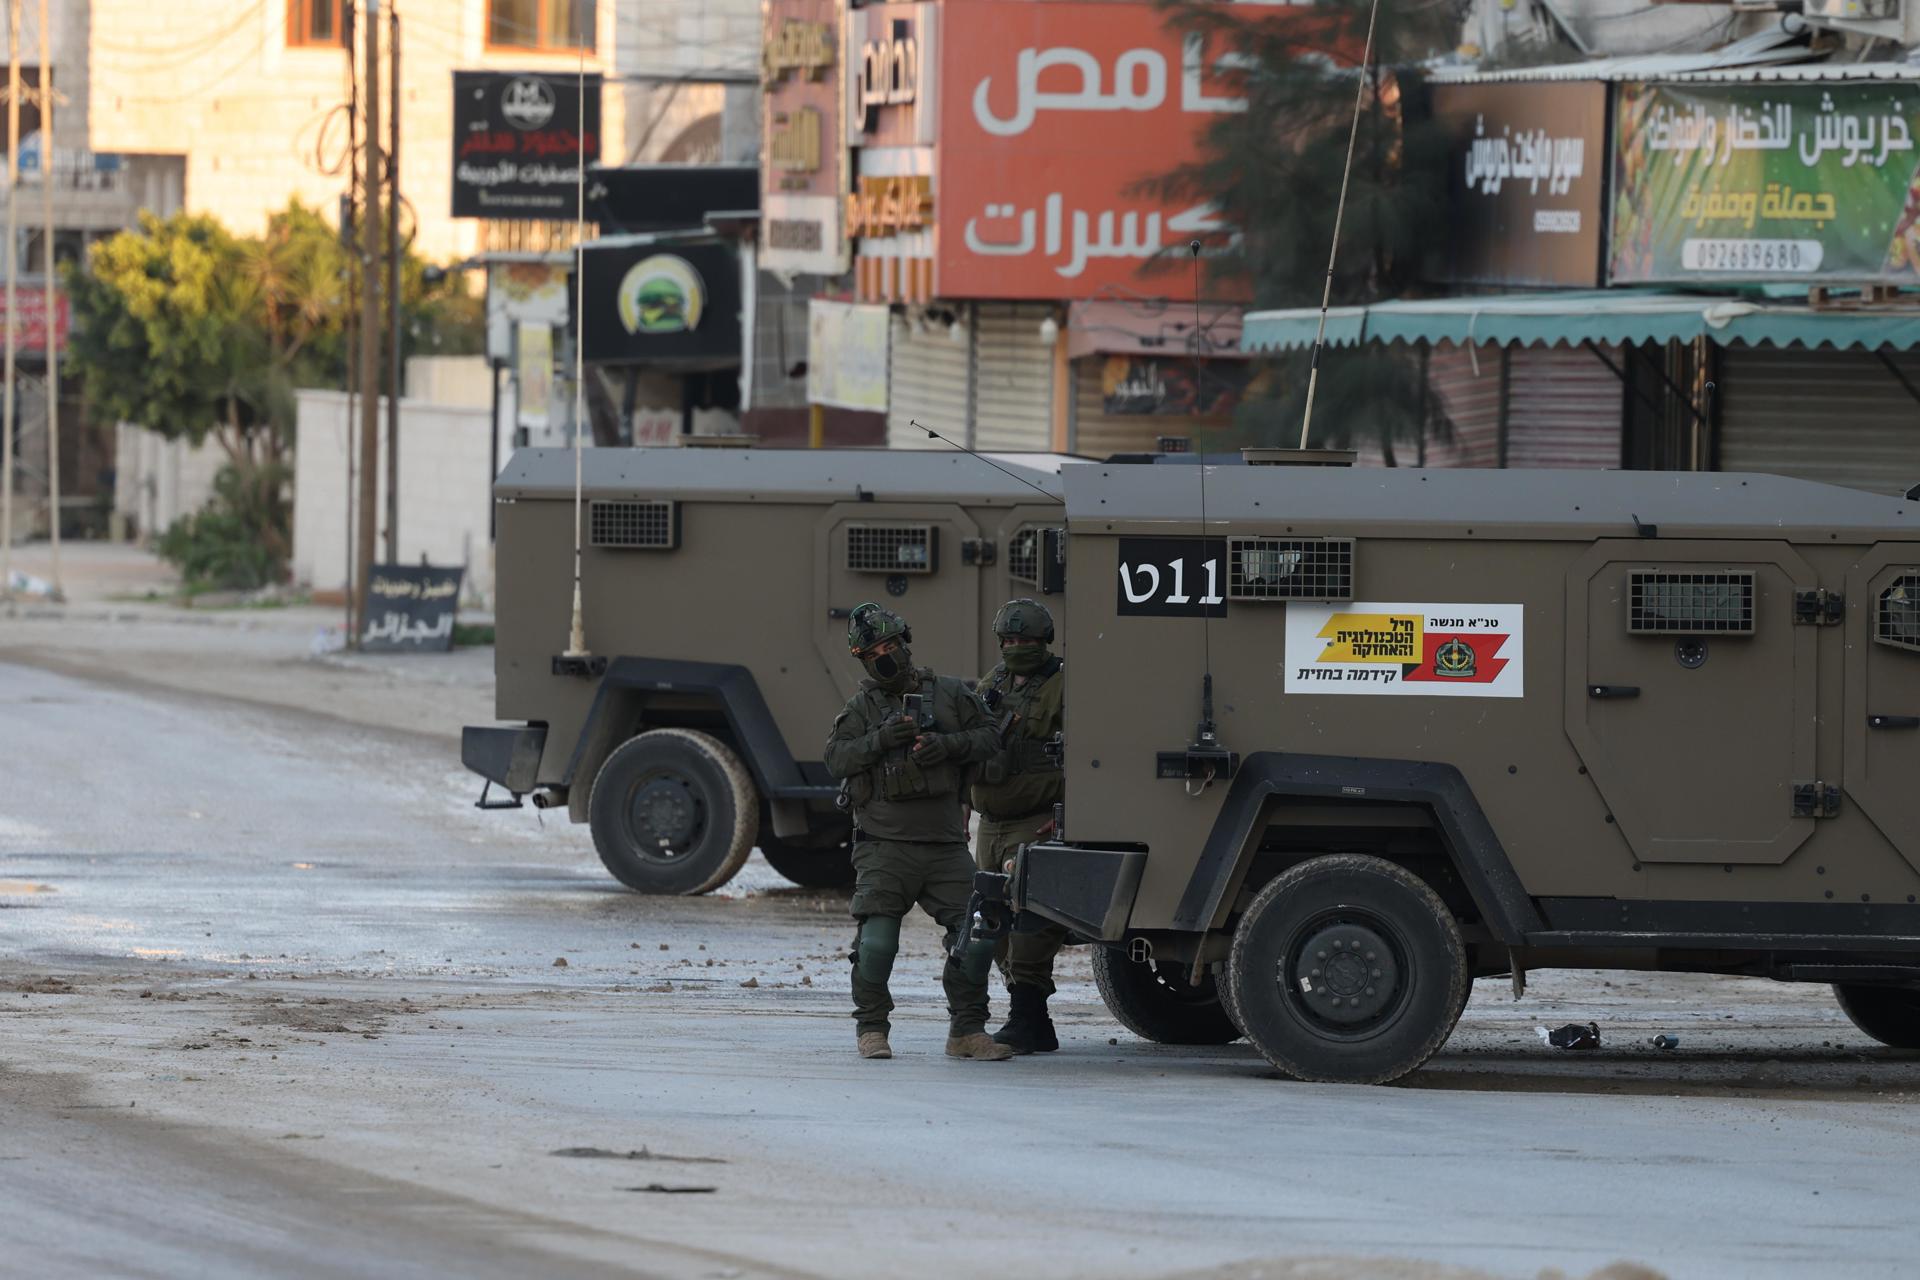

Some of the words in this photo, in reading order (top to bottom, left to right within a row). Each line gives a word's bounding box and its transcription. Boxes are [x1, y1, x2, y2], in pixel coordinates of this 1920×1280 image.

[1800, 91, 1914, 167] خريوش
[1761, 183, 1837, 229] جملة
[964, 193, 1248, 278] كسرات
[360, 610, 454, 645] الجزائر
[1389, 617, 1414, 632] חיל
[1429, 617, 1464, 628] מנשה
[1468, 617, 1499, 628] טנ"א
[1336, 629, 1414, 644] הטכנולוגיה
[1352, 643, 1414, 658] והאחזקה
[1297, 667, 1343, 681] בחזית
[1346, 668, 1398, 684] קידמה
